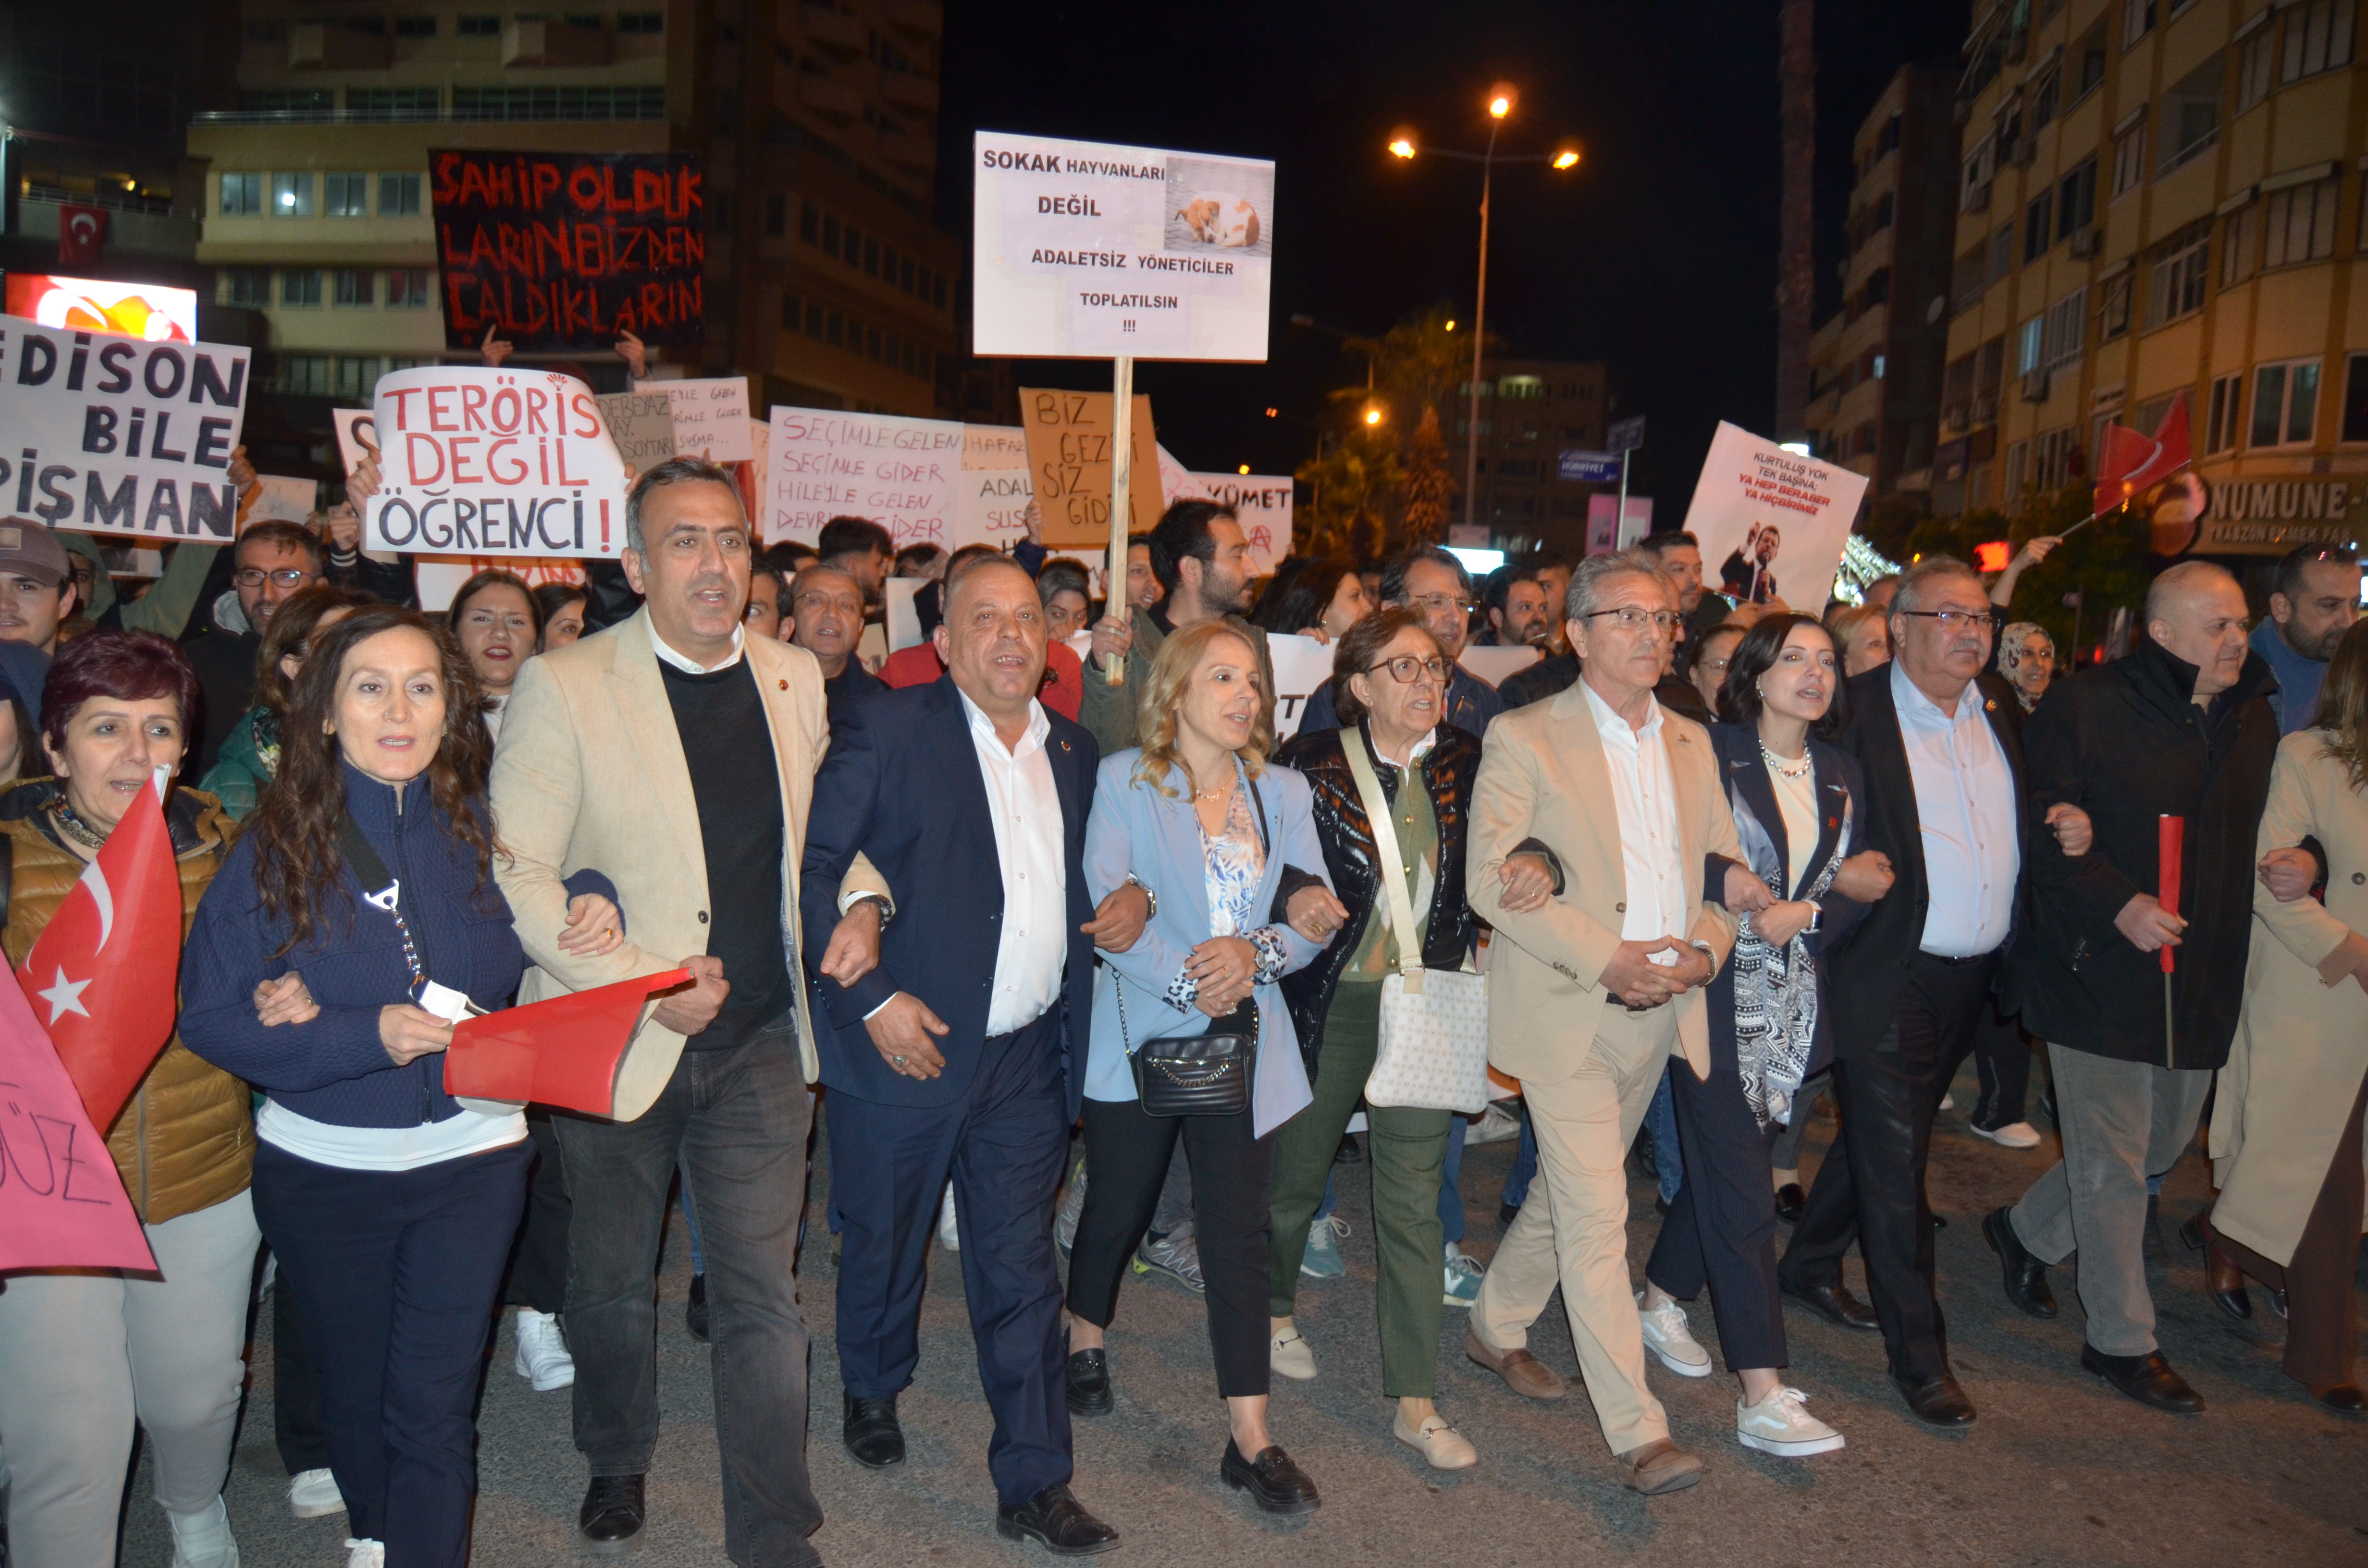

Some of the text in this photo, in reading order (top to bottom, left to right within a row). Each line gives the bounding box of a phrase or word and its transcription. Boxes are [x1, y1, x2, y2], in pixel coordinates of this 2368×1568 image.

[983, 149, 1165, 181] SOKAK HAYVANLARI
[432, 153, 703, 220] SAHİP OLDUK
[1038, 194, 1101, 217] DEĞİL
[1031, 249, 1234, 275] ADALETSİZ YÖNETİCİLER
[1080, 293, 1178, 308] TOPLATILSIN
[1123, 319, 1136, 332] !!!
[0, 330, 247, 408] DİSON
[383, 374, 600, 439] TERÖRİS
[670, 390, 698, 402] EYLE
[1036, 393, 1095, 425] BİZ
[674, 410, 706, 424] RİMLE
[82, 405, 233, 469] BİLE
[783, 416, 961, 450] SEÇİMLE GELEN
[406, 429, 589, 486] DEĞİL
[783, 450, 865, 476] SEÇİMLE
[876, 462, 946, 482] GİDER
[1754, 452, 1829, 481] KURTULUŞ YOK
[1759, 466, 1778, 479] TEK
[778, 480, 933, 509] HİLEYLE GELEN
[980, 478, 1033, 497] ADAL
[1043, 463, 1092, 499] SİZ
[1739, 473, 1831, 506] YA HEP BERABER
[1745, 488, 1819, 515] YA HİÇBİRİMİZ
[2212, 481, 2349, 520] NUMUNE
[986, 510, 1026, 531] SUS
